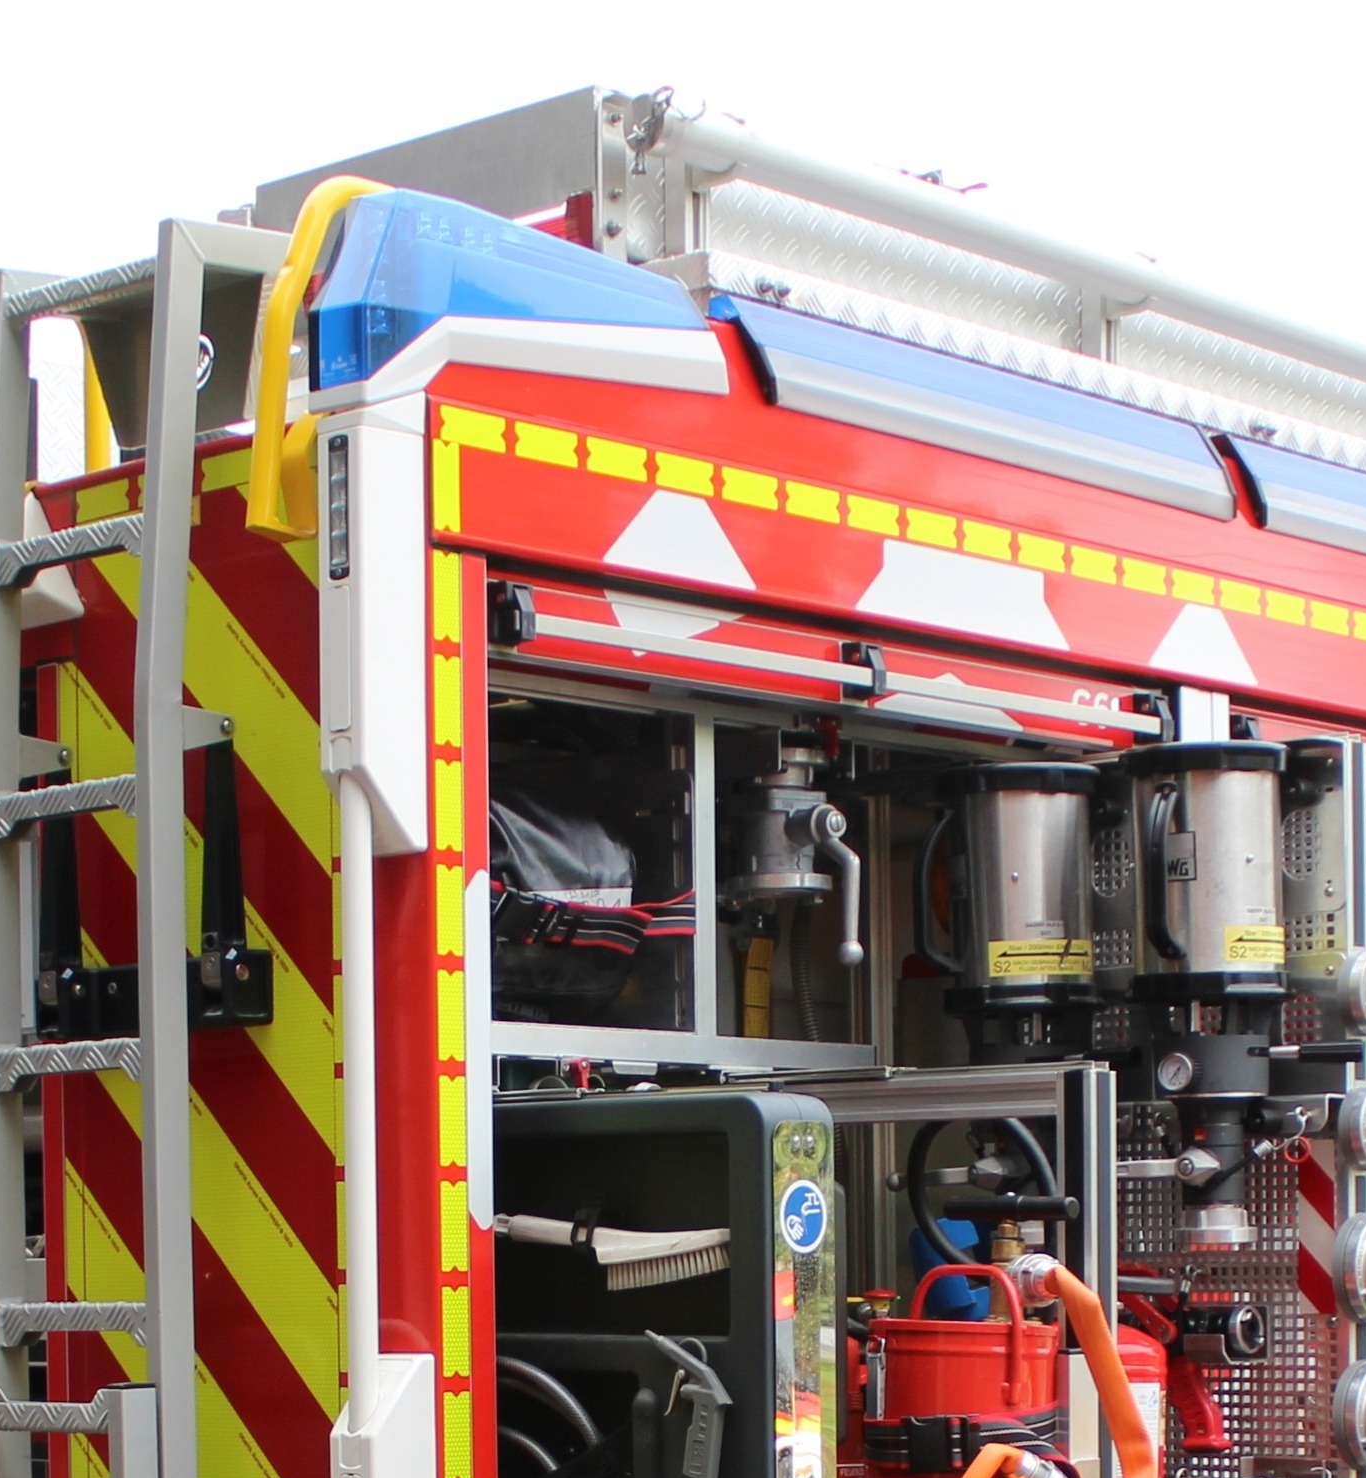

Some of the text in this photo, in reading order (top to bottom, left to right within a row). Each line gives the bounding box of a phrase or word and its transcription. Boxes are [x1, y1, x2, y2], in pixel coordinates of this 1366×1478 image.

[1167, 857, 1190, 877] WG
[1229, 945, 1248, 959] S2
[993, 960, 1012, 973] S2
